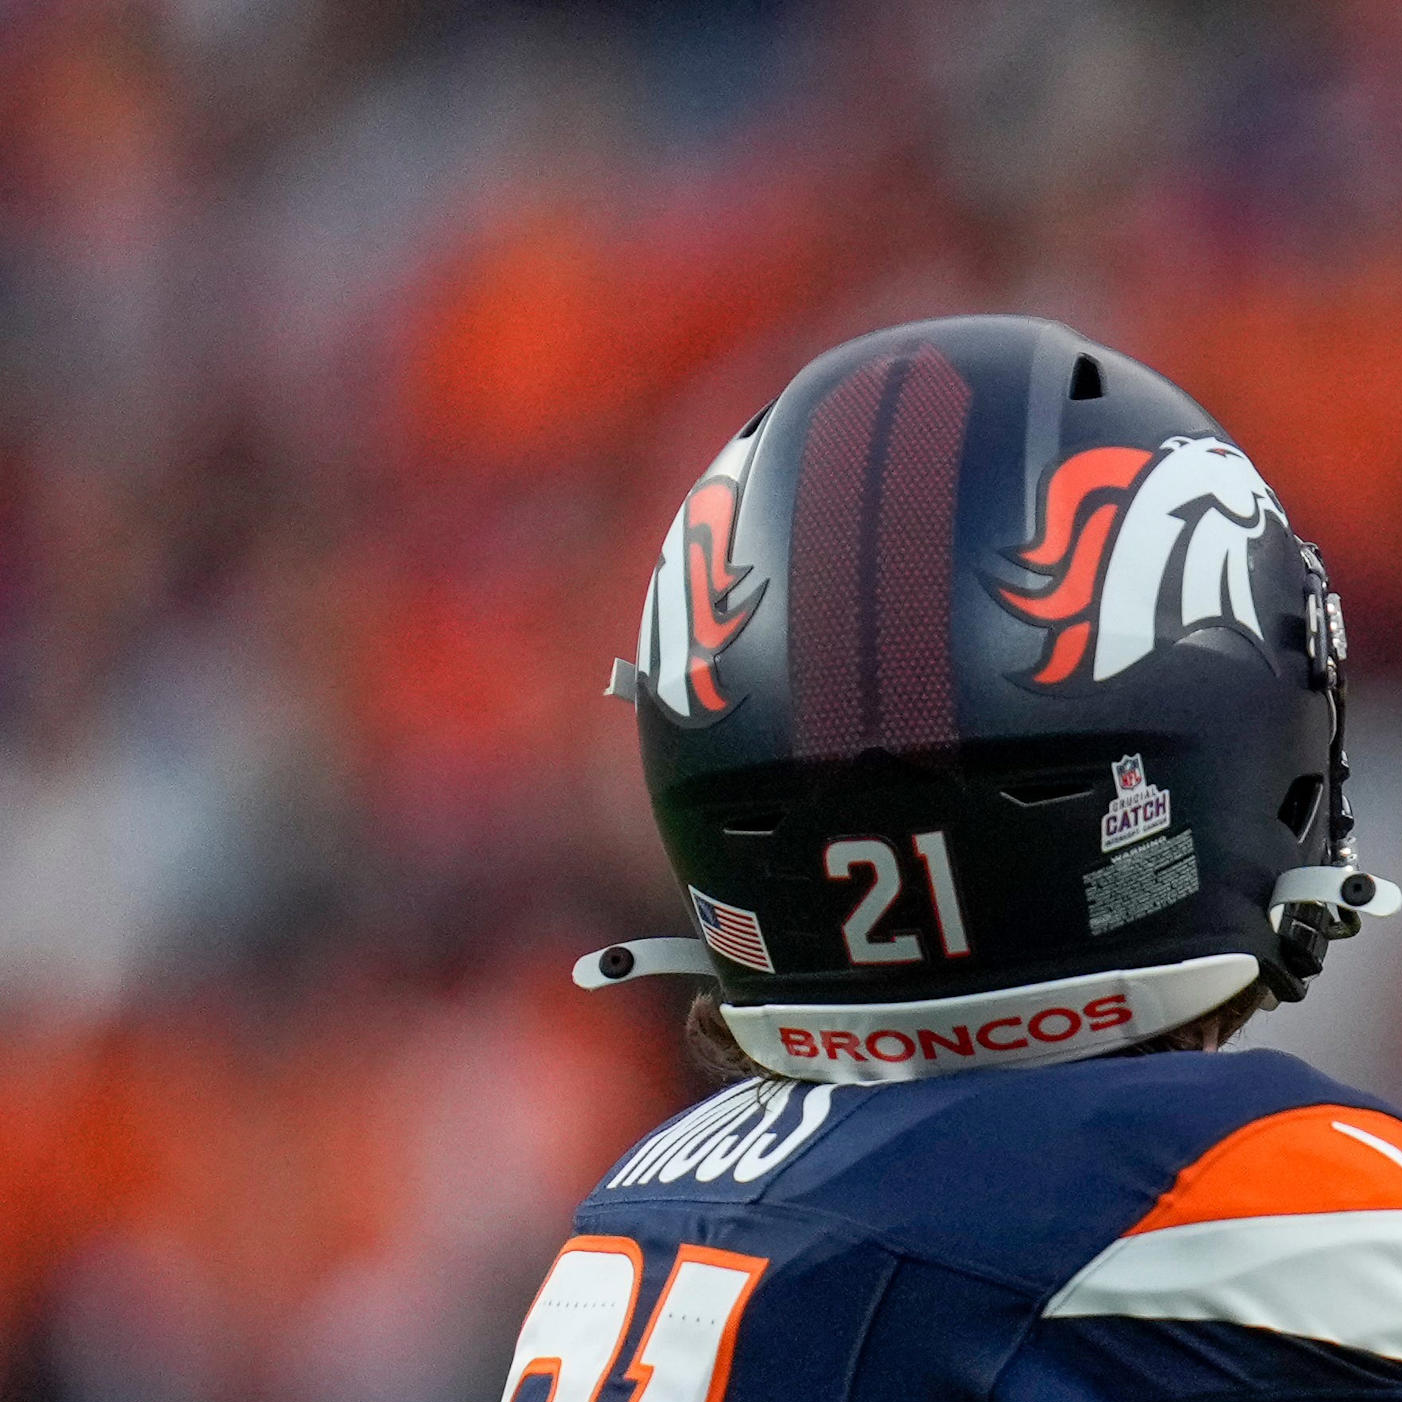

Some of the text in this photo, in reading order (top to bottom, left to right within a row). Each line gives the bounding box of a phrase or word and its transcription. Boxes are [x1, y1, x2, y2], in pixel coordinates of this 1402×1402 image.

[1106, 793, 1166, 837] CATCH
[823, 830, 971, 965] 21
[779, 993, 1134, 1062] BRONCOS
